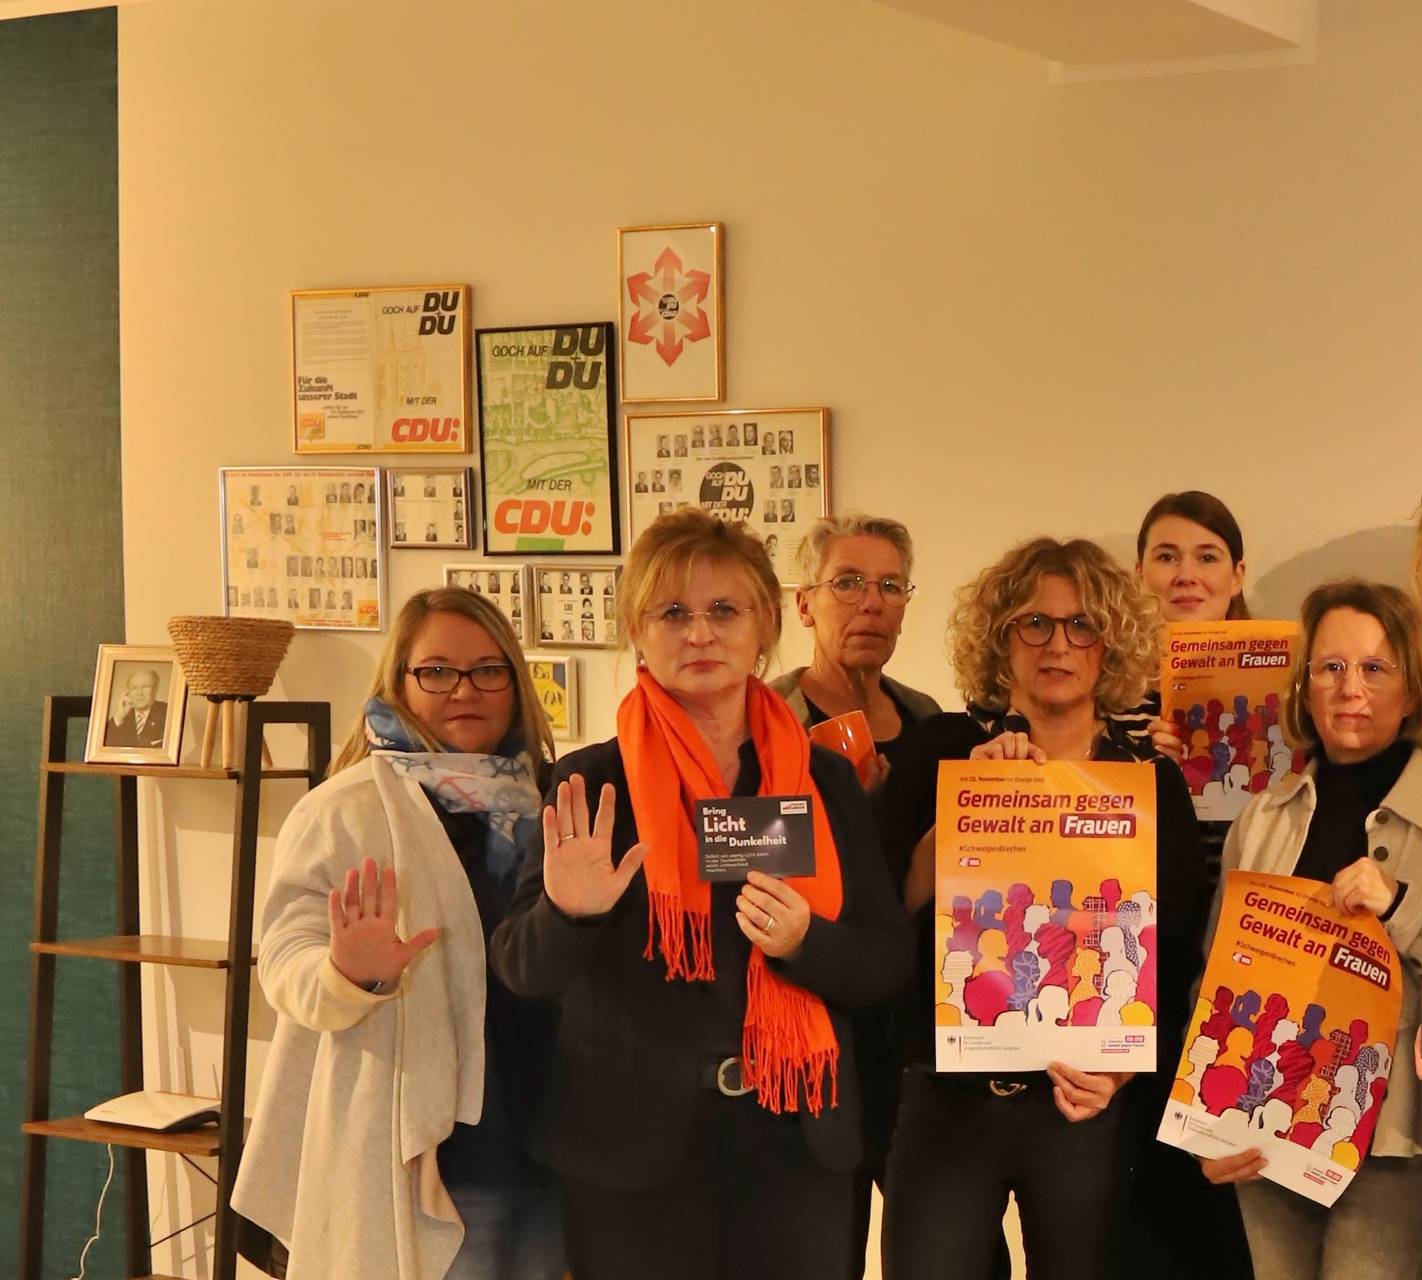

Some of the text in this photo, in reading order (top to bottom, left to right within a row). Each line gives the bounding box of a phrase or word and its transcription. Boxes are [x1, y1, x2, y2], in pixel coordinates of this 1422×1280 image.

[382, 291, 460, 314] GOCH AUF DU
[419, 315, 456, 335] DU
[492, 327, 605, 357] GOCH AUF DU
[545, 361, 602, 390] DU
[335, 392, 357, 400] Stadt
[406, 397, 437, 405] MIT DER
[527, 479, 572, 491] MIT DER
[724, 470, 750, 486] DU
[721, 486, 749, 501] DU
[1171, 639, 1289, 652] Gemeinsam gegen
[1171, 654, 1287, 669] Gewalt an Frauen
[957, 790, 1134, 812] Gemeinsam gegen
[702, 807, 726, 816] Bring
[704, 816, 746, 832] Licht
[957, 815, 1132, 835] Gewalt an Frauen
[705, 835, 788, 847] in die Dunkelheit
[1244, 891, 1391, 964] Gemeinsam gegen
[1239, 914, 1388, 986] Gewalt an Frauen
